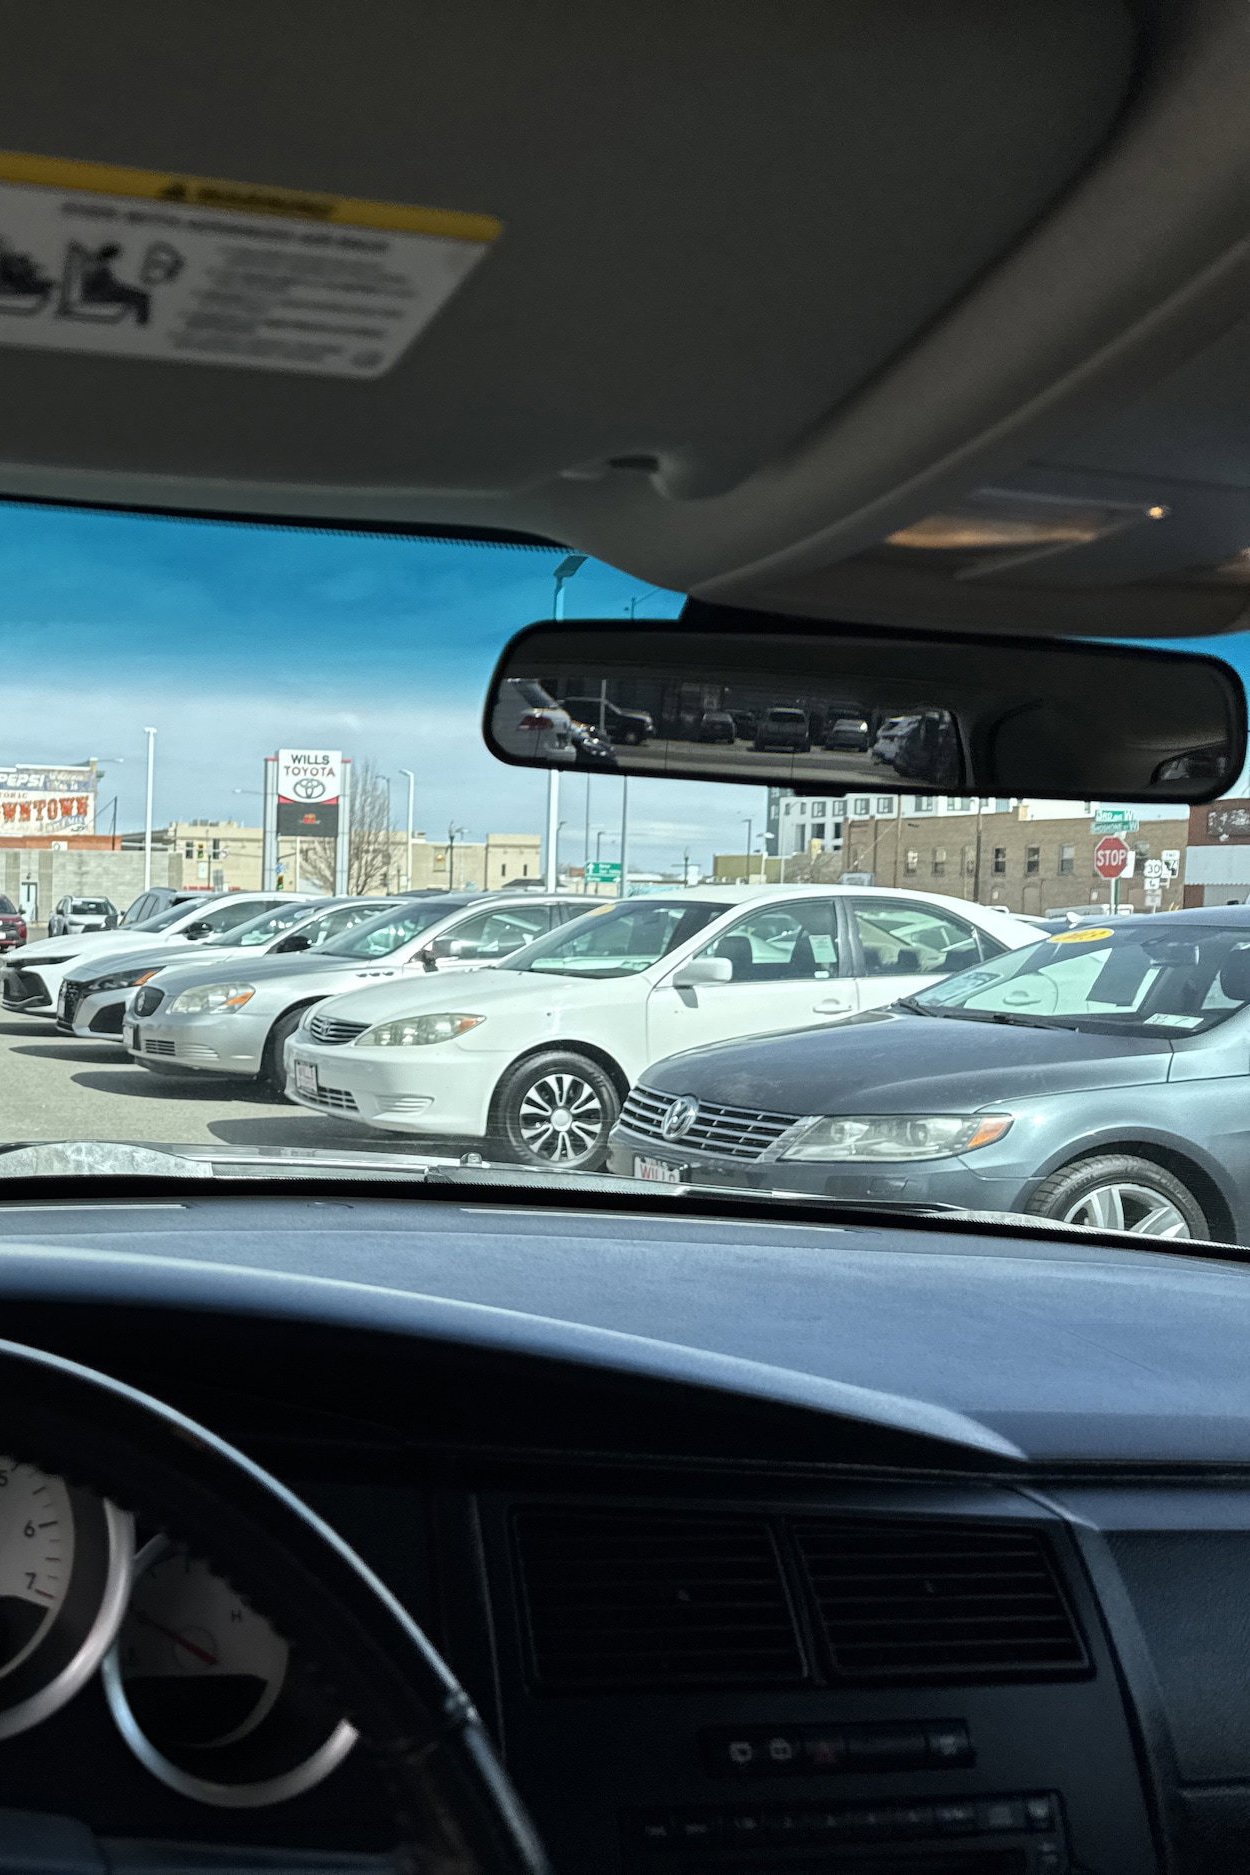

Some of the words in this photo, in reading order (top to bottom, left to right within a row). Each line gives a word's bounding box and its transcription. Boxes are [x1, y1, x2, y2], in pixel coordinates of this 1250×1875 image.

[291, 754, 330, 766] WILLS
[284, 765, 336, 777] TOYOTA
[1096, 849, 1127, 867] STOP
[1147, 863, 1161, 874] 30
[24, 1520, 36, 1538] 6
[25, 1572, 37, 1590] 7
[230, 1609, 242, 1623] H
